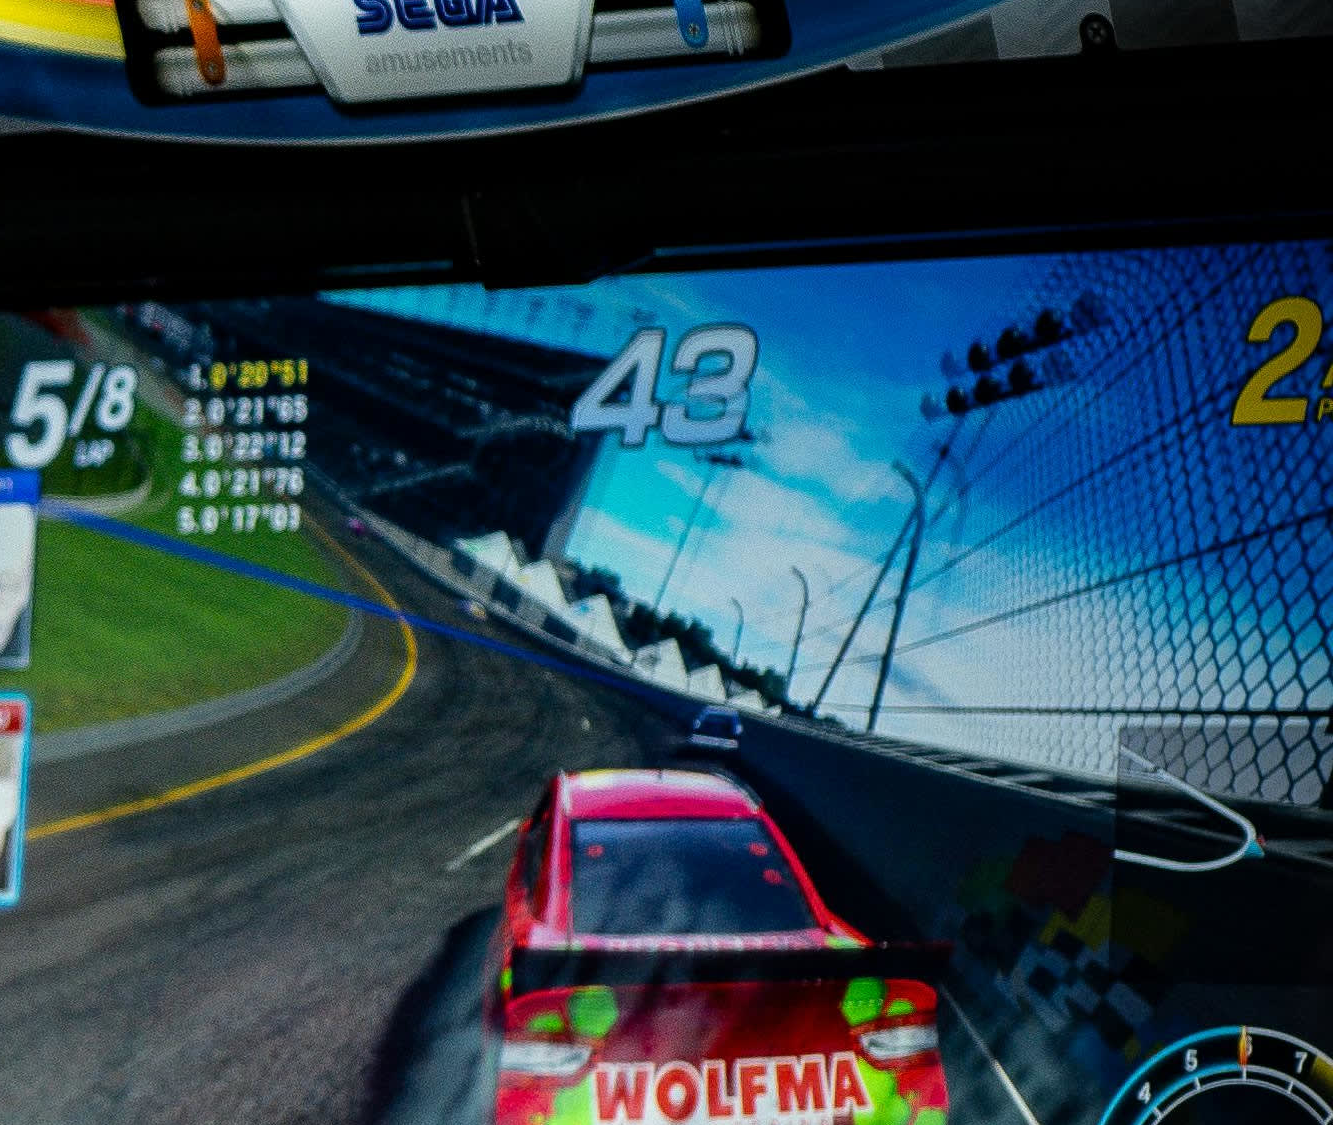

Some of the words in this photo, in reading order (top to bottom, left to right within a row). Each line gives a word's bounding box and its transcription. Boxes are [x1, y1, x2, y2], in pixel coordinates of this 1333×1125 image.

[354, 0, 525, 34] SEGA
[366, 41, 533, 75] amusements
[570, 323, 759, 446] 43
[5, 359, 138, 468] 5/8
[1184, 1049, 1198, 1072] 5
[1294, 1051, 1308, 1073] 7
[593, 1057, 871, 1125] WOLFMA
[1137, 1081, 1152, 1104] 4
